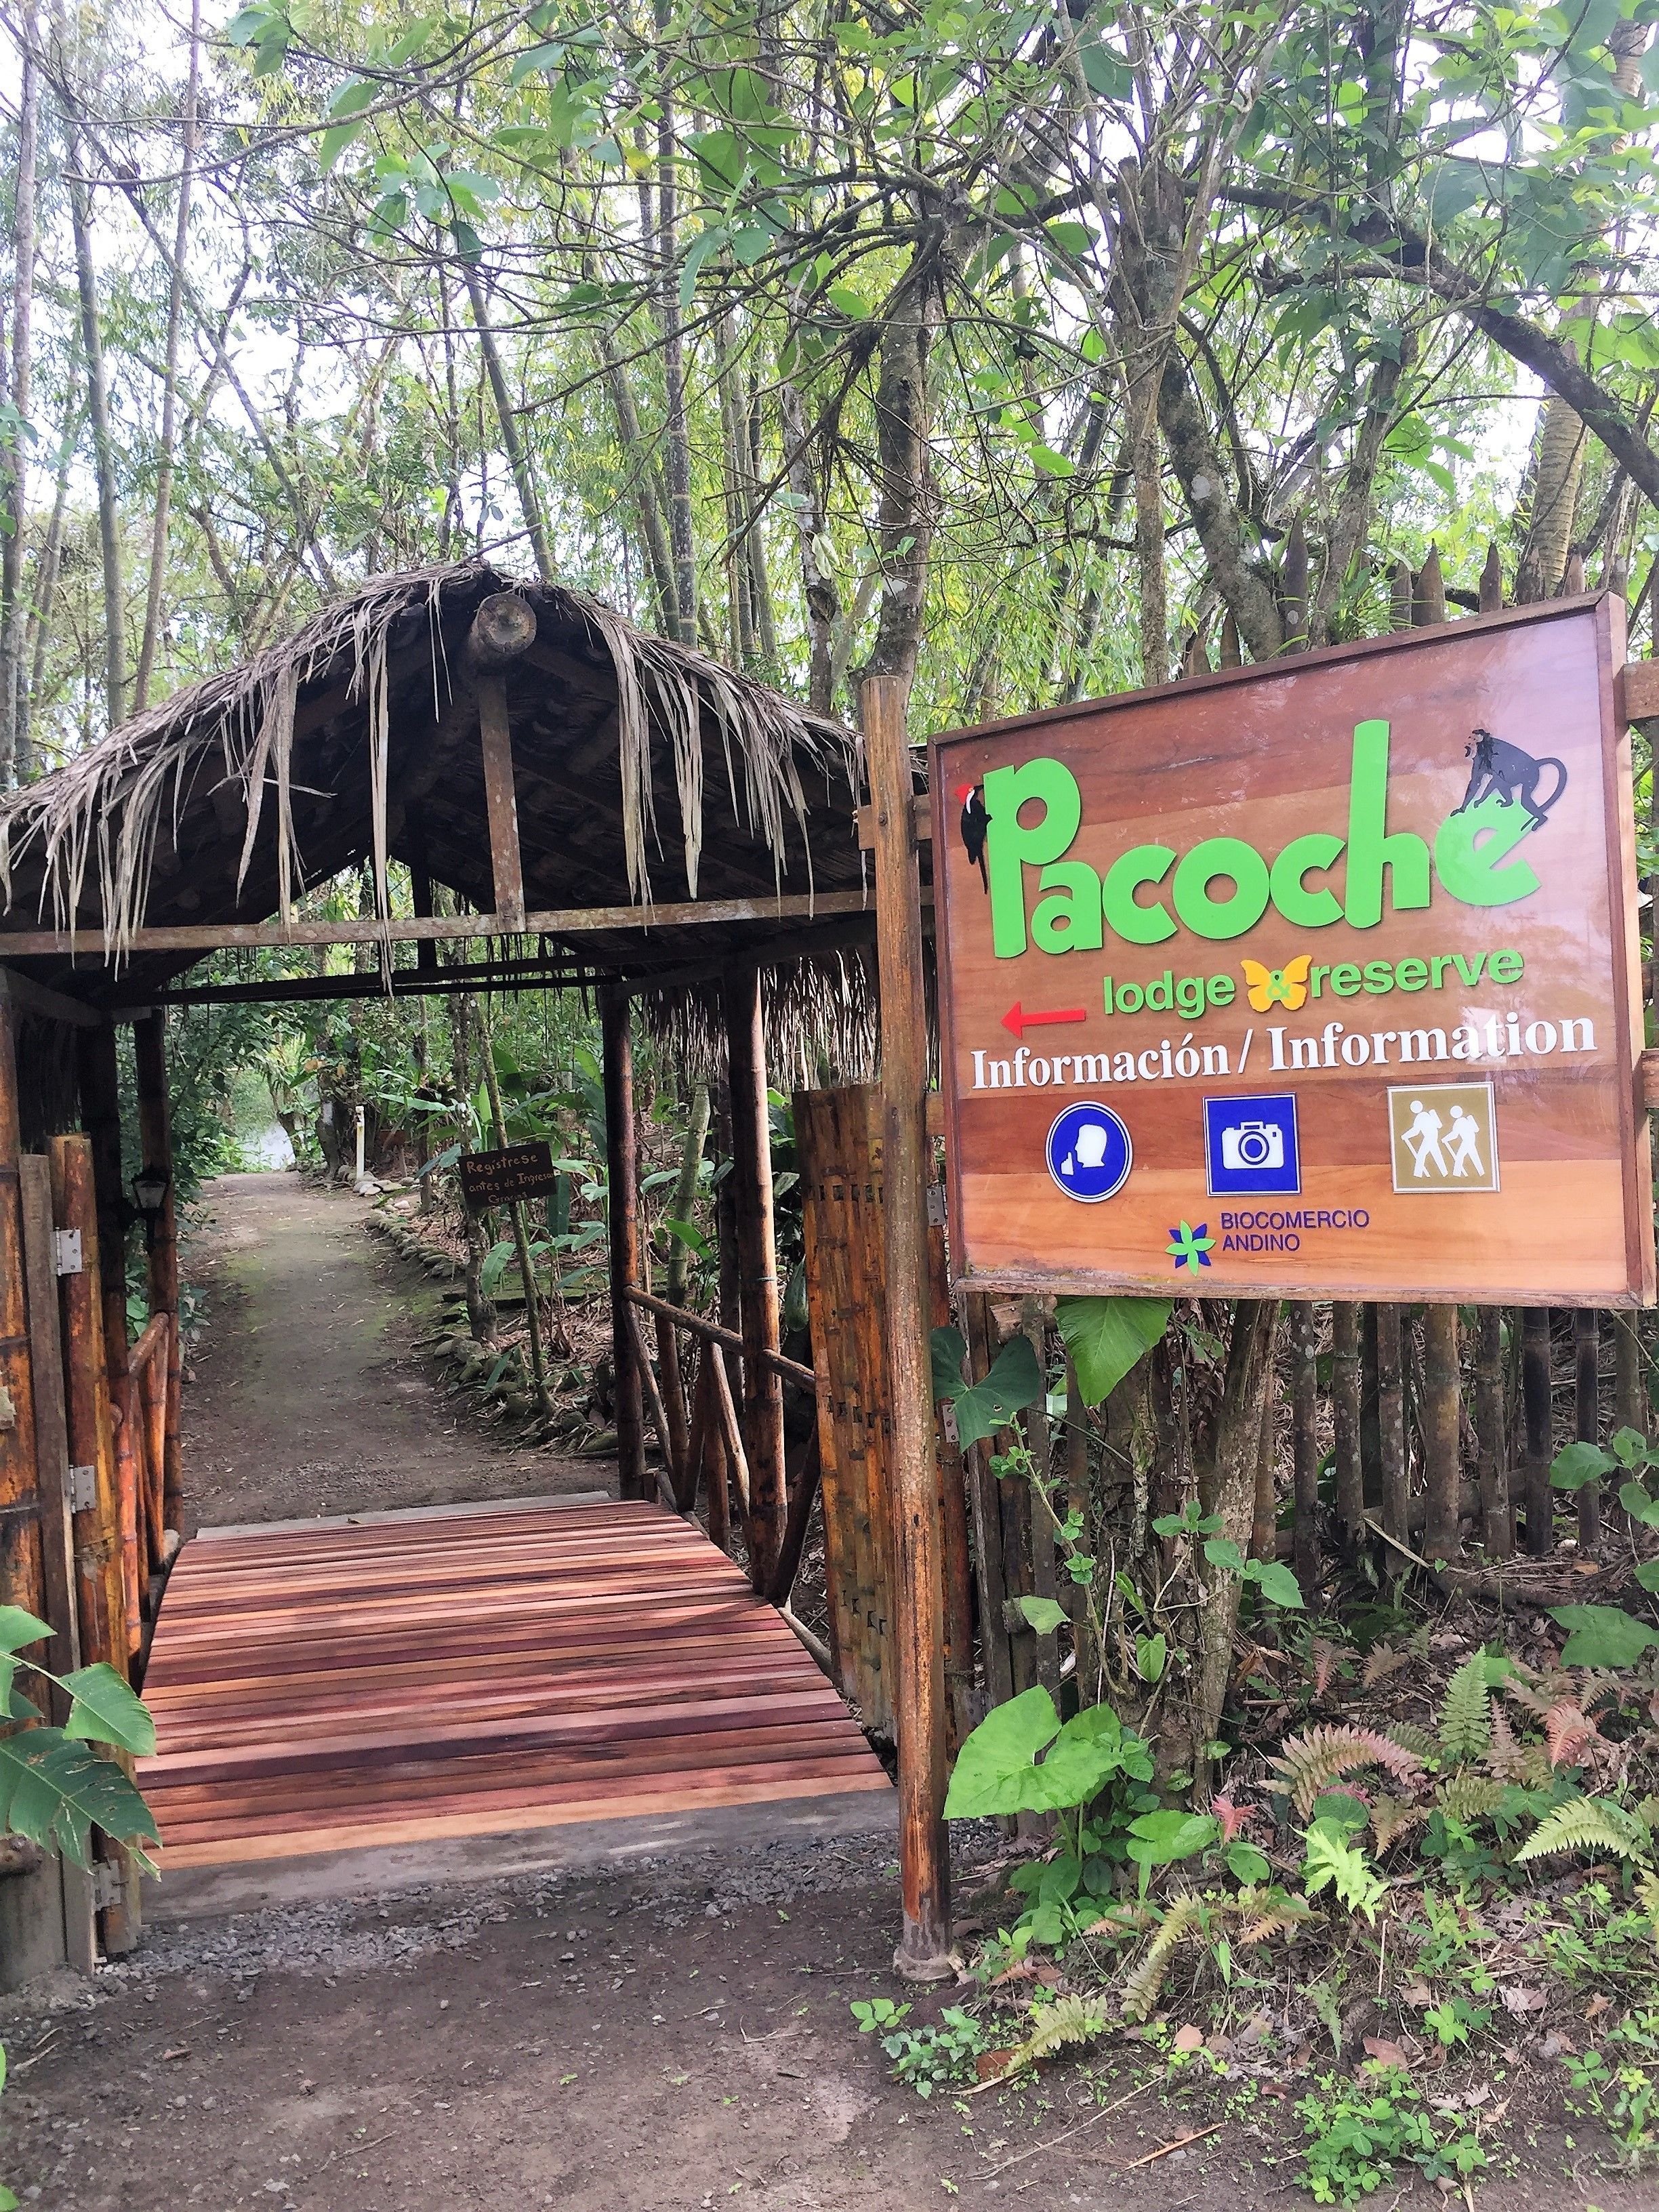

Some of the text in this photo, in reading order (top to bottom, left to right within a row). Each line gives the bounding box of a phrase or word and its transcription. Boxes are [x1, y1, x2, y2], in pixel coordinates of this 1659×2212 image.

[983, 719, 1542, 958] Pacoche
[1103, 948, 1525, 1019] lodge & reserve
[970, 1034, 1230, 1090] Información
[1269, 1011, 1596, 1070] Information
[469, 1181, 499, 1192] antes
[504, 1179, 515, 1187] de
[1220, 1210, 1370, 1229] BIOCOMERCIO
[1221, 1232, 1301, 1252] ANDINO
